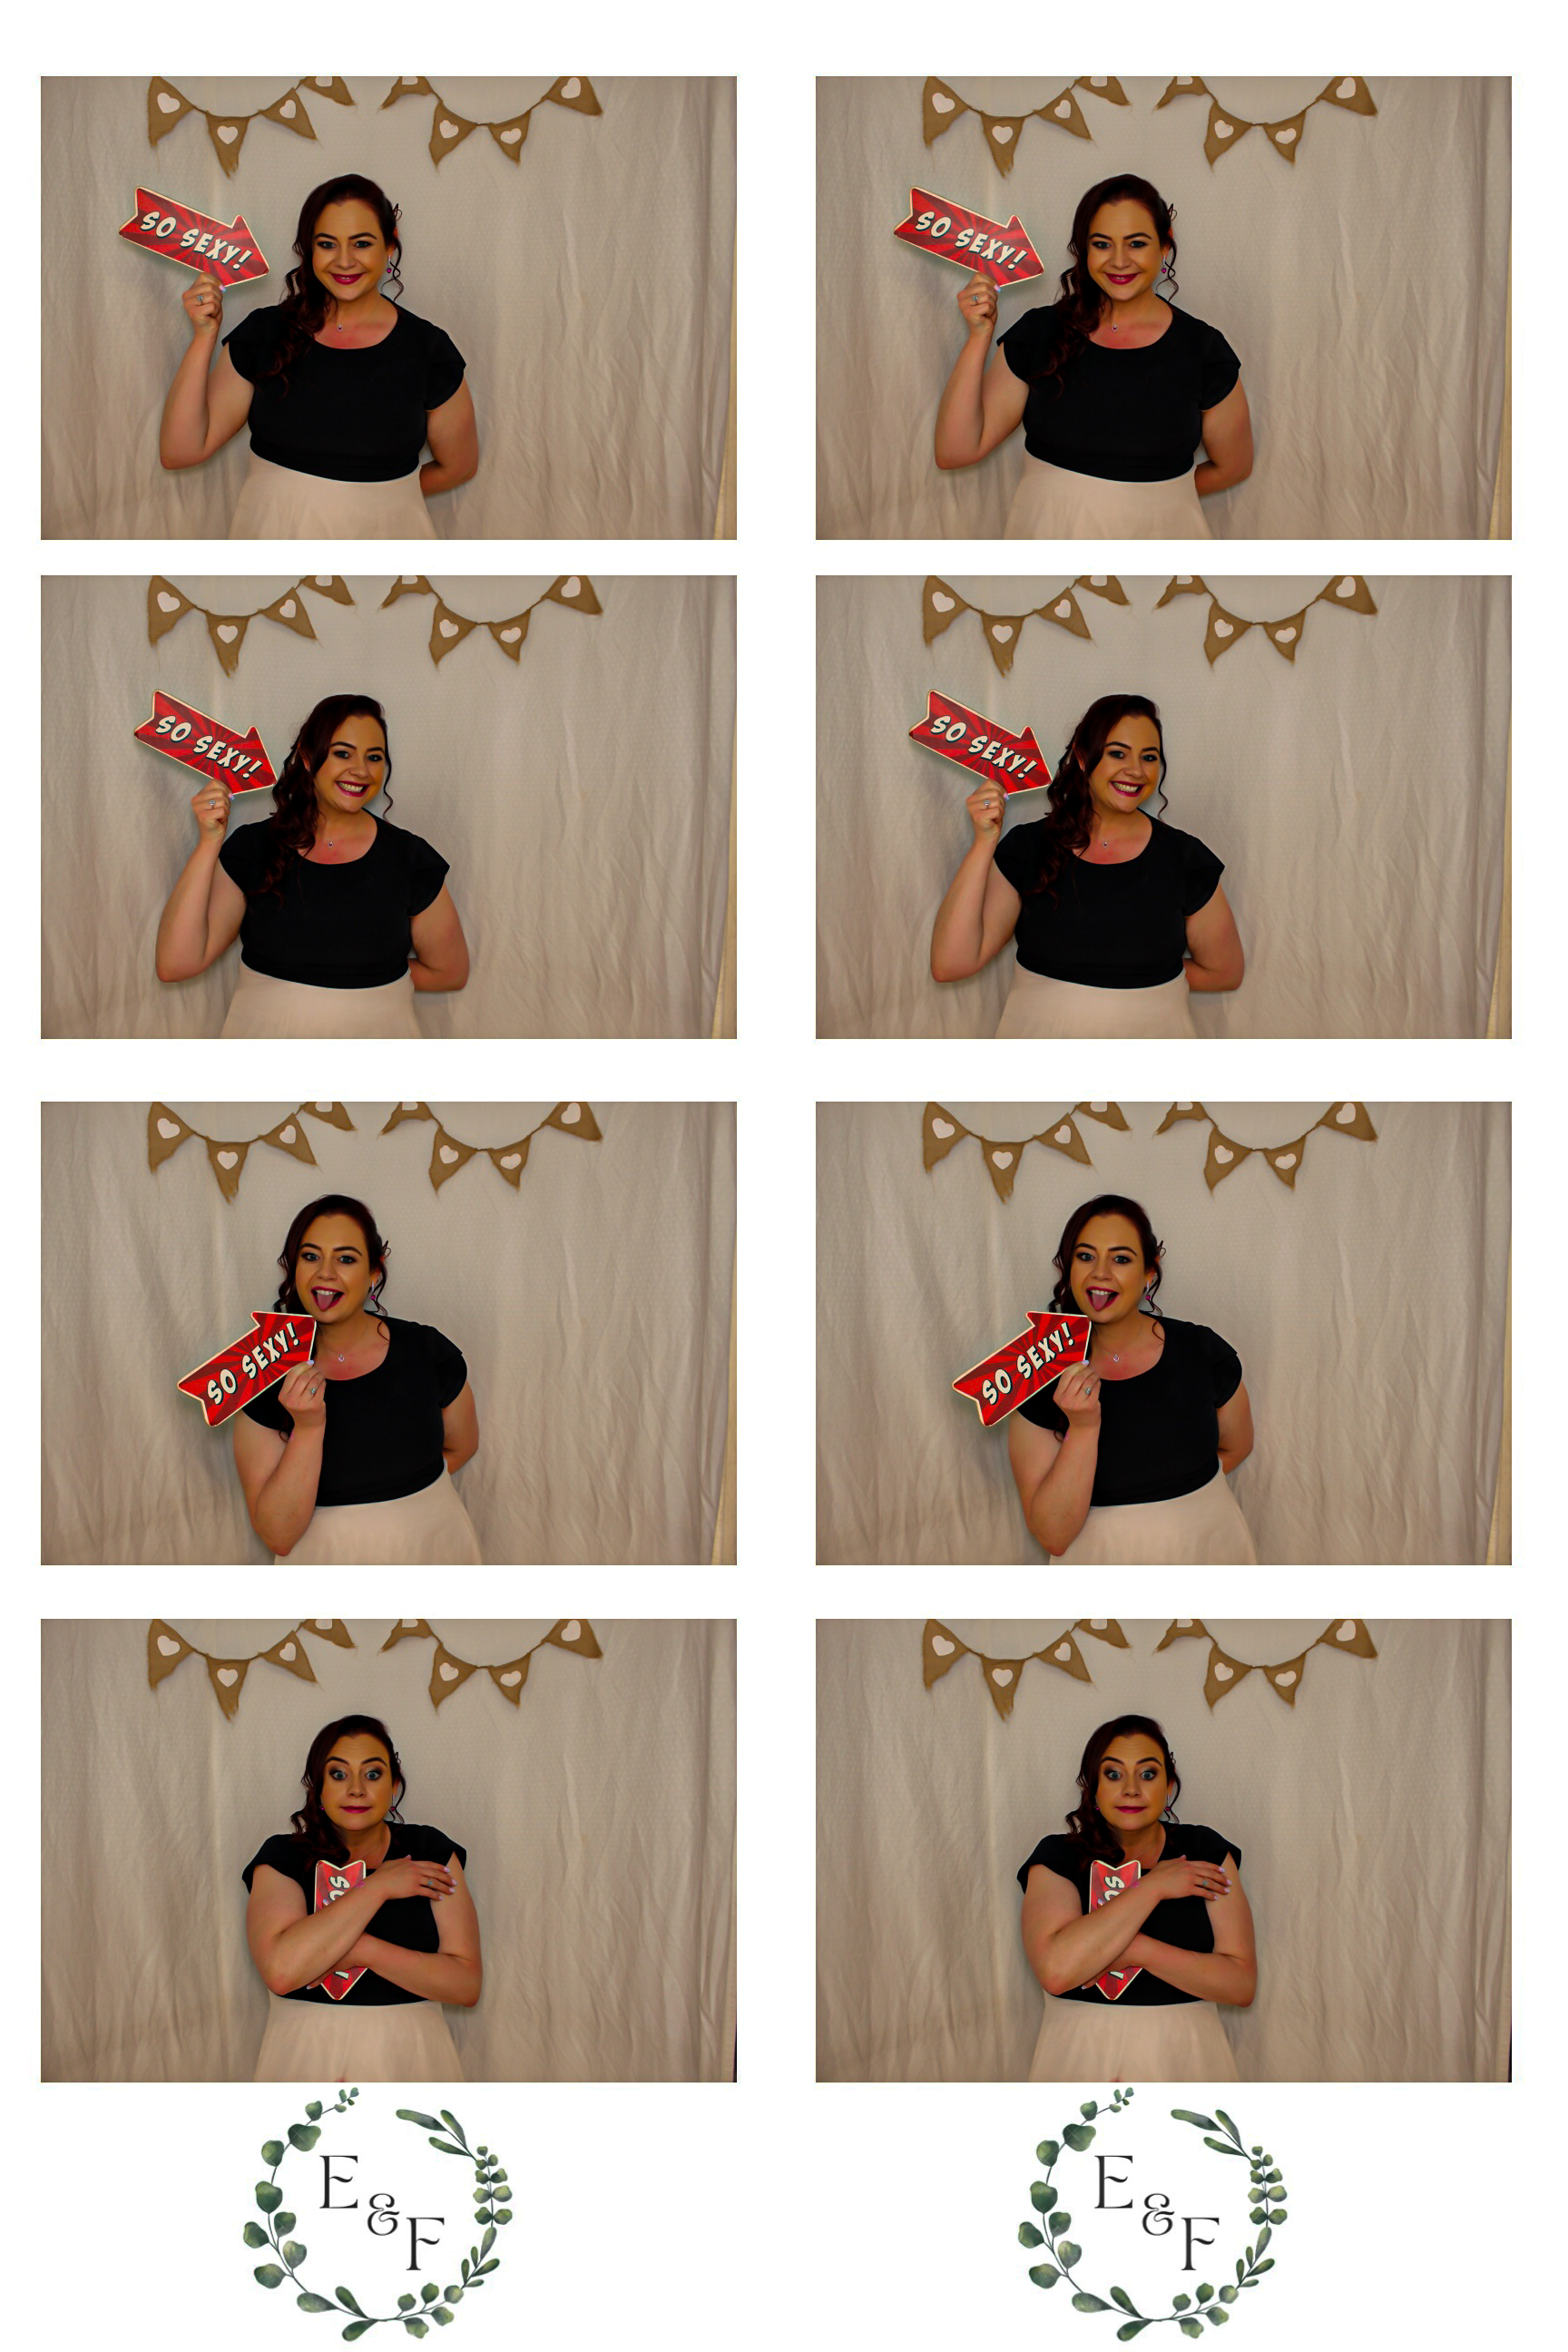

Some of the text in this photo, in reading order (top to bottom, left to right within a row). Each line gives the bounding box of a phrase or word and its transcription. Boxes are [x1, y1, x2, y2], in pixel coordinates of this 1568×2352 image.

[140, 211, 252, 270] SO SEXY!
[915, 211, 1027, 270] SO SEXY!
[155, 715, 263, 779] SO SEXY!
[930, 715, 1038, 779] SO SEXY!
[207, 1322, 300, 1406] SO SEXY!
[982, 1322, 1075, 1406] SO SEXY!
